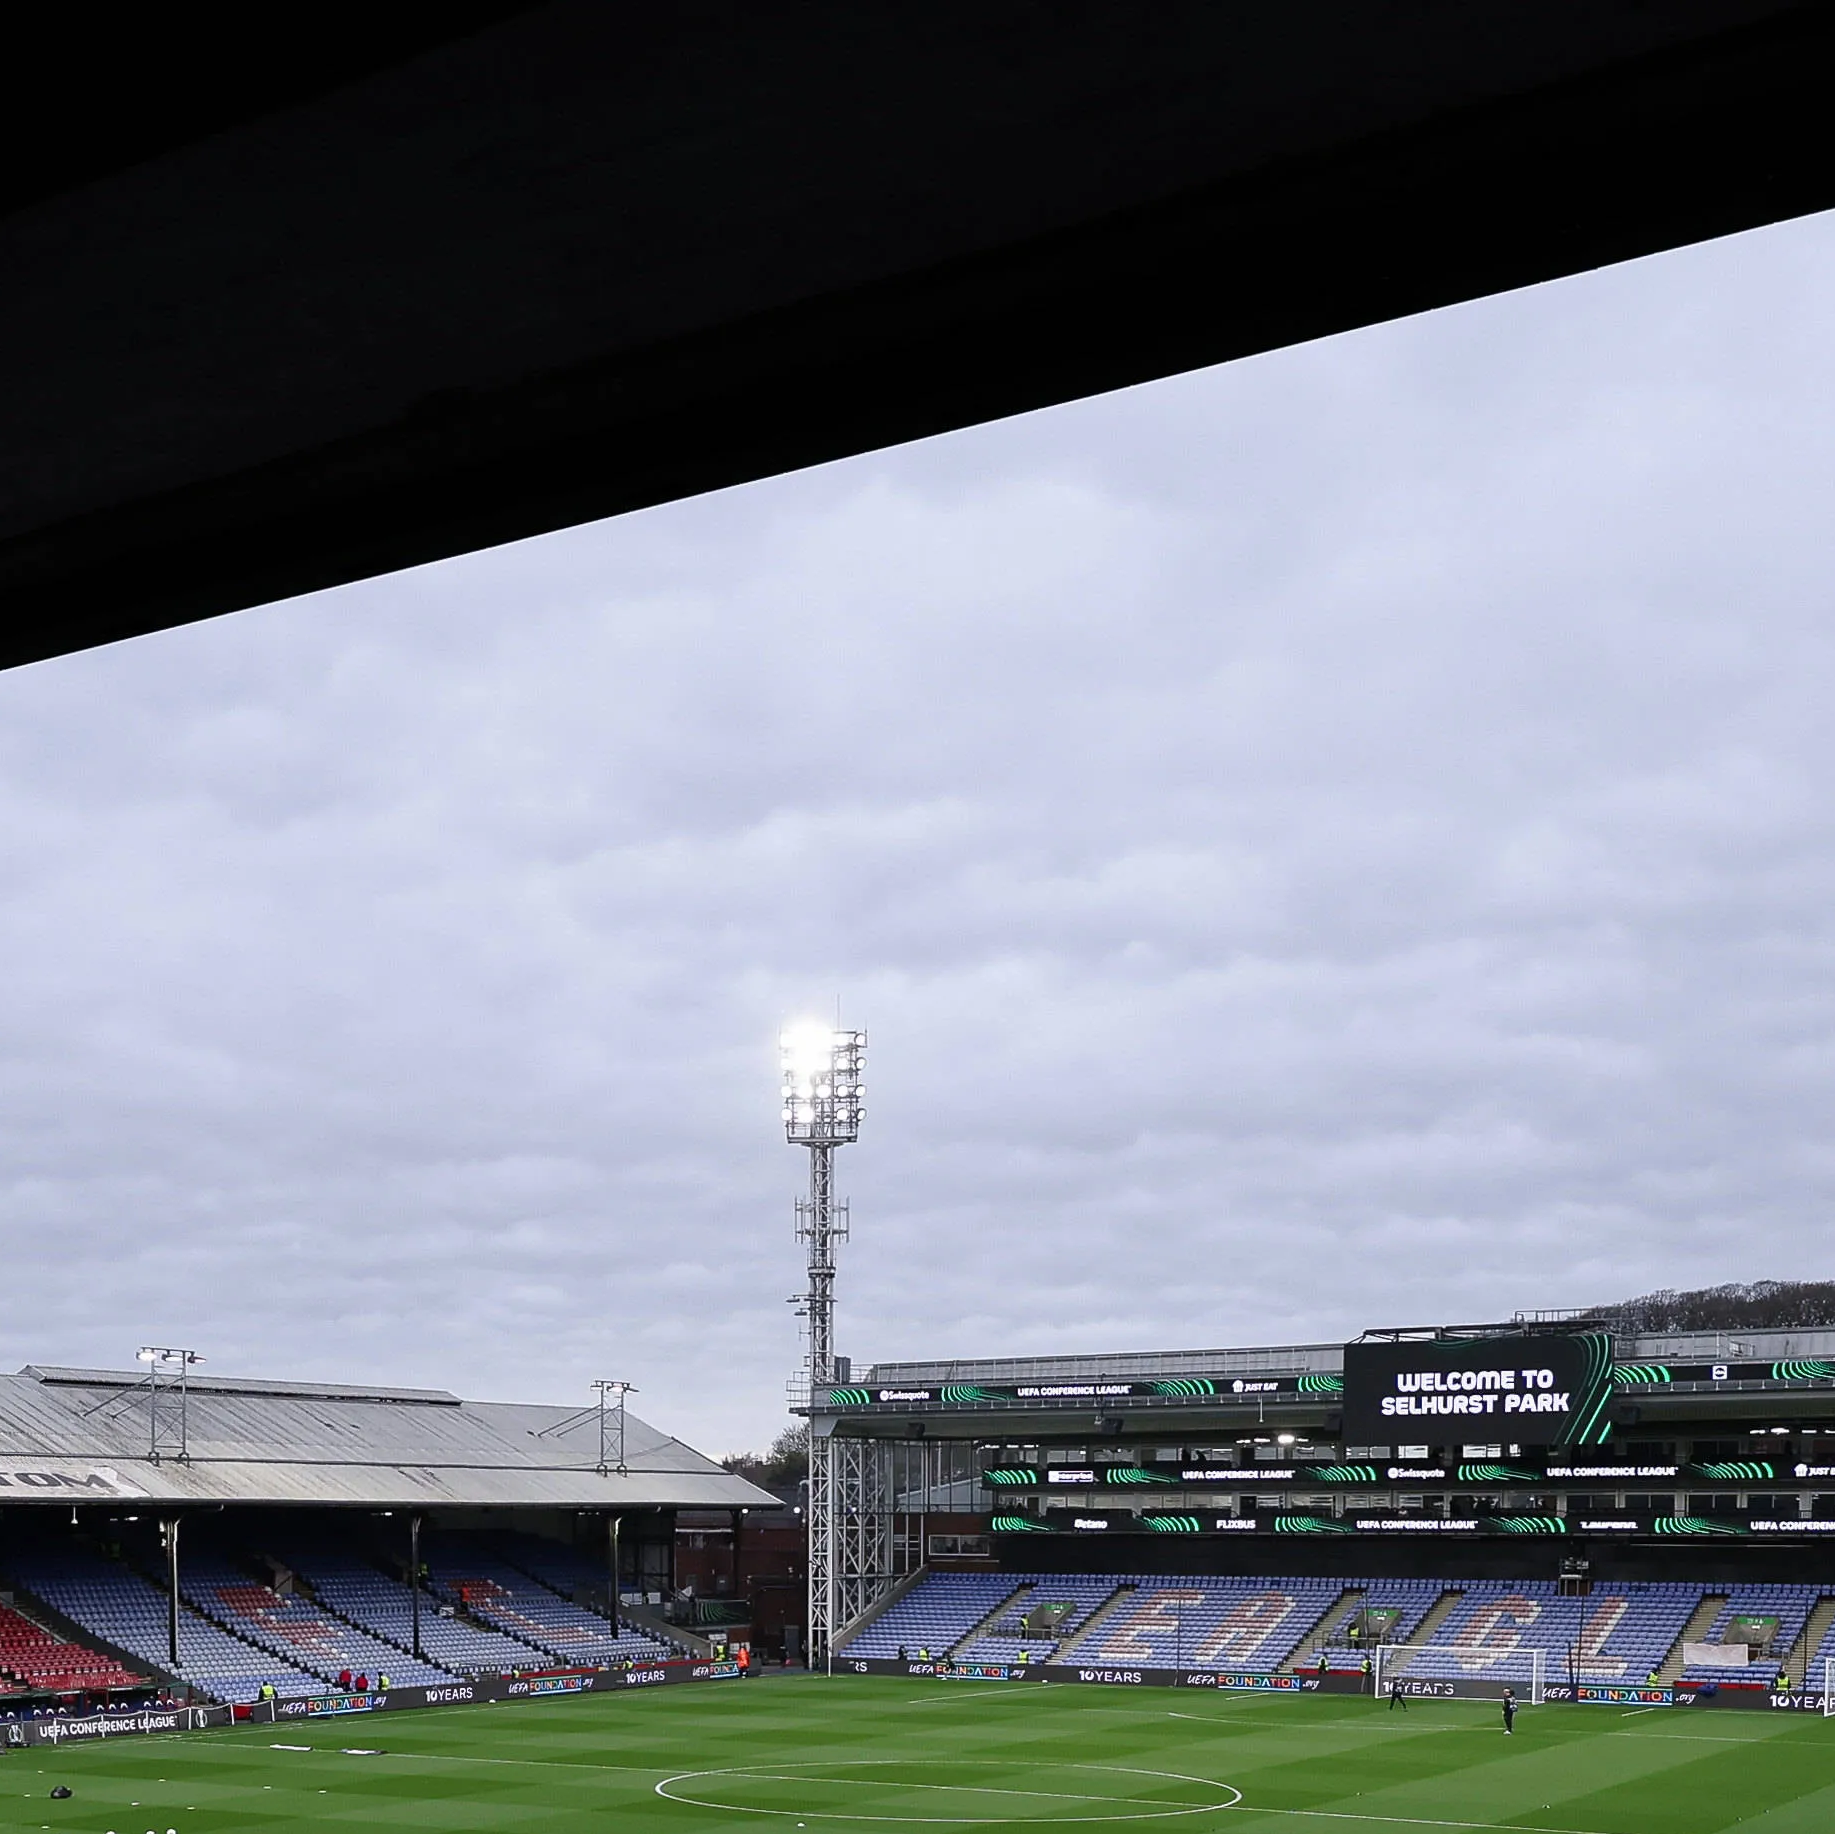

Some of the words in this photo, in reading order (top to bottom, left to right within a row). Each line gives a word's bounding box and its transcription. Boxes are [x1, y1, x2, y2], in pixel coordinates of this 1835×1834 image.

[1397, 1370, 1515, 1393] WELCOME
[1522, 1368, 1554, 1389] TO
[1017, 1387, 1040, 1396] UEFA
[1040, 1386, 1095, 1395] CONFERENCE
[1096, 1385, 1130, 1394] LEAGUE
[1243, 1382, 1263, 1392] JUST
[1263, 1382, 1279, 1391] EAT
[888, 1391, 930, 1401] Swissquote
[1381, 1394, 1498, 1416] SELHURST
[1505, 1392, 1570, 1413] PARK
[1182, 1470, 1204, 1479] UEFA
[1205, 1470, 1258, 1479] CONFERENCE
[1259, 1470, 1292, 1479] LEAGUE
[1398, 1468, 1445, 1479] Swissquote
[1547, 1467, 1572, 1477] UEFA
[1573, 1467, 1636, 1476] CONFERENCE
[1637, 1466, 1676, 1476] LEAGUE
[1808, 1467, 1830, 1476] JUST
[1074, 1519, 1108, 1529] Betano
[1216, 1520, 1256, 1529] FLIXBUS
[1356, 1520, 1380, 1529] UEFA
[1381, 1520, 1439, 1530] CONFERENCE
[1440, 1520, 1475, 1530] LEAGUE
[1750, 1521, 1778, 1530] UEFA
[908, 1664, 934, 1674] UEFA
[509, 1681, 528, 1694] UEFA
[529, 1678, 582, 1691] FOUNDATION
[1187, 1675, 1215, 1685] UEFA
[1218, 1675, 1300, 1689] FOUNDATION
[1577, 1689, 1672, 1701] FOUNDATION
[308, 1696, 372, 1711] FOUNDATION
[39, 1725, 69, 1738] UEFA
[69, 1719, 136, 1736] CONFERENCE
[137, 1715, 176, 1729] LEAGUE
